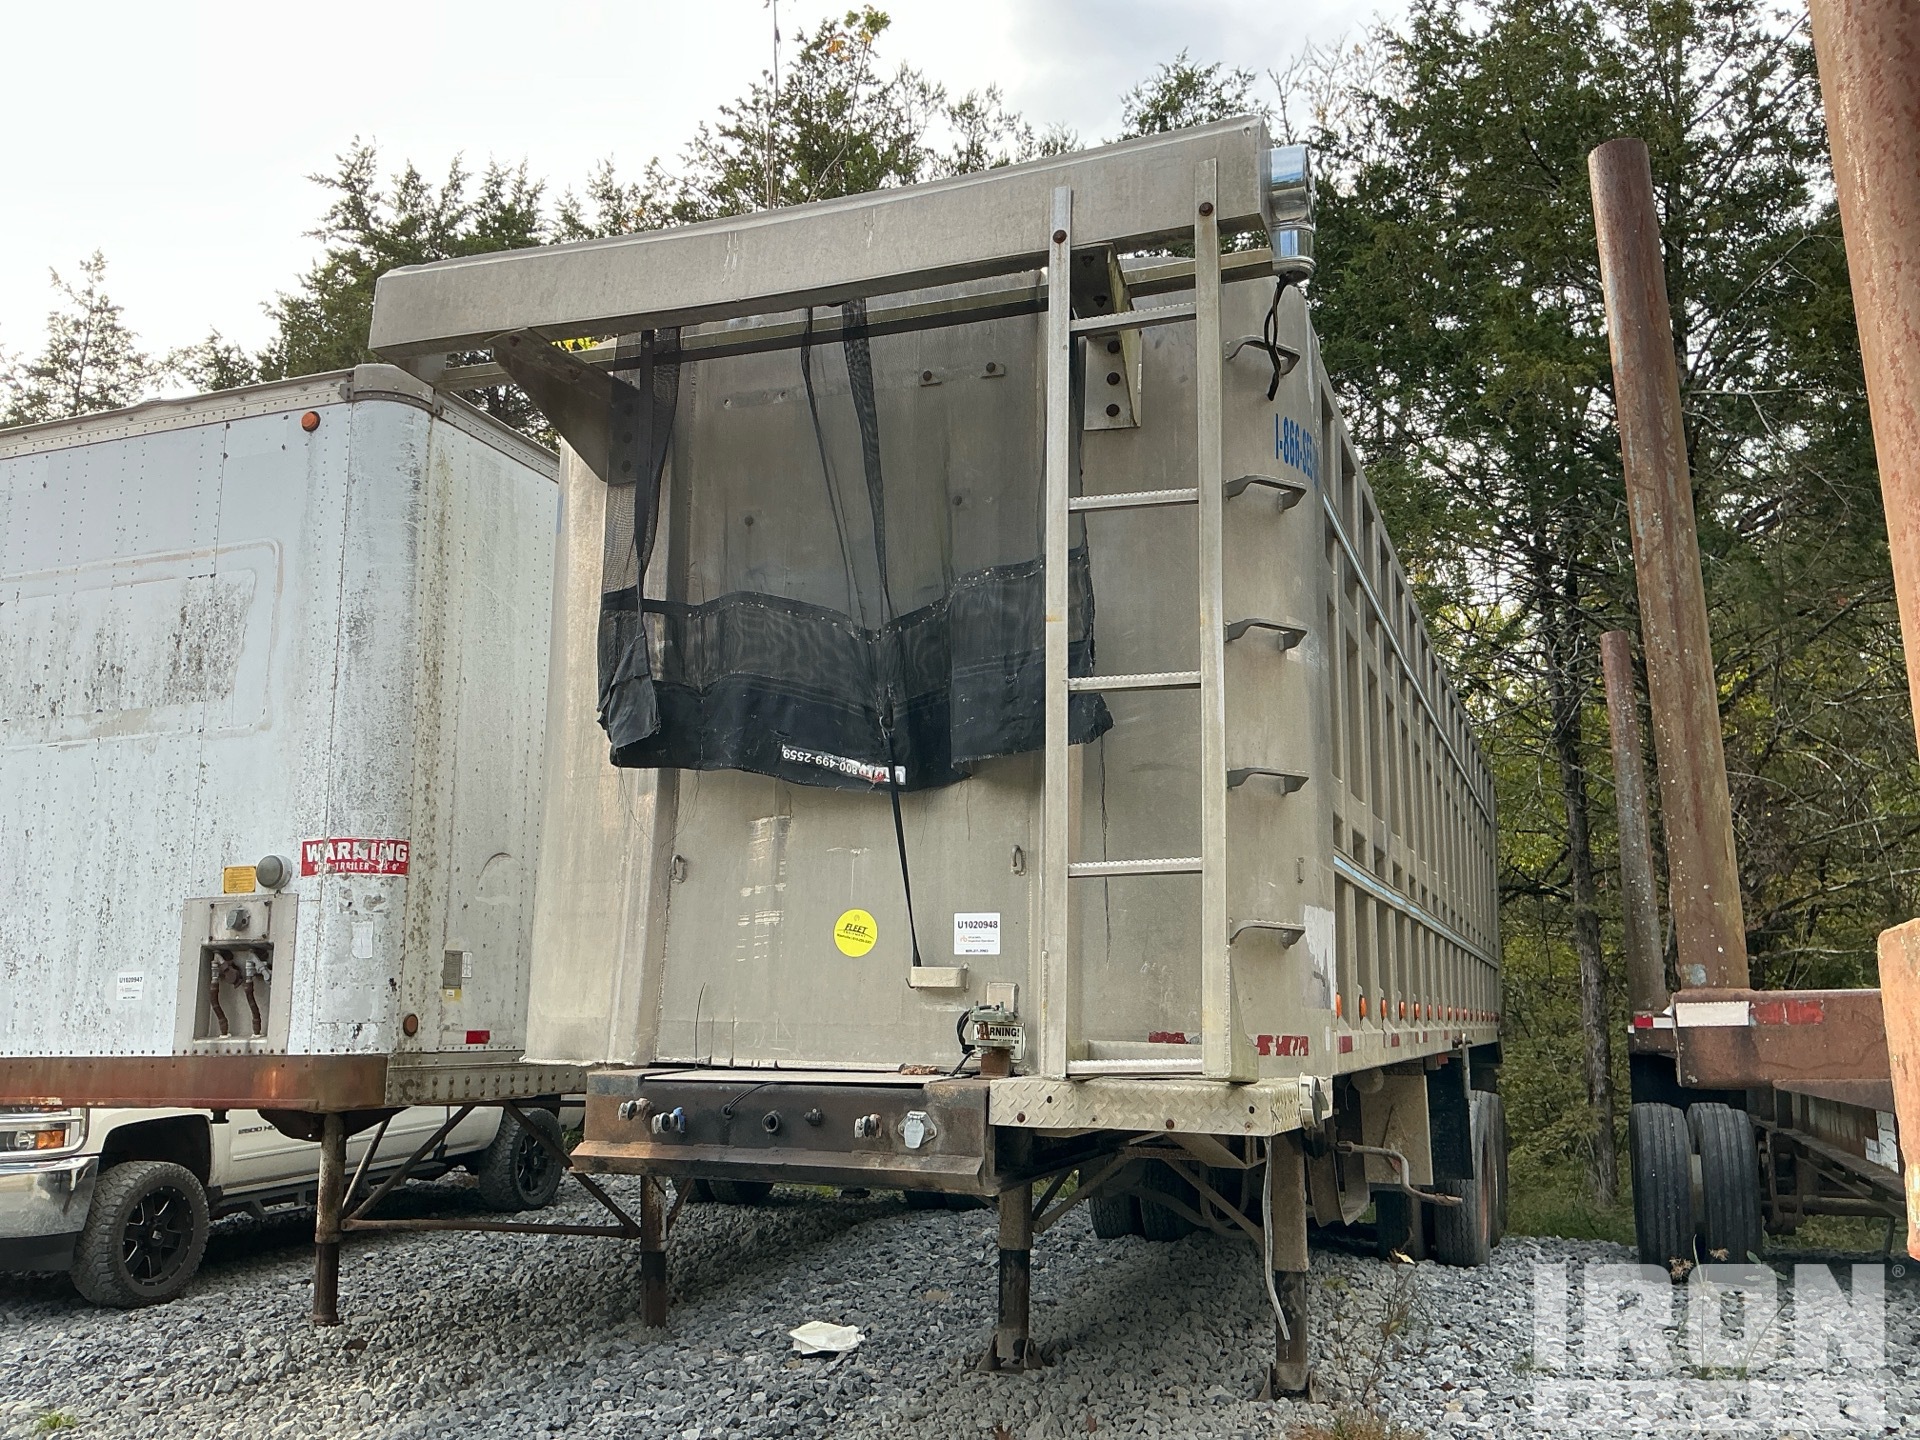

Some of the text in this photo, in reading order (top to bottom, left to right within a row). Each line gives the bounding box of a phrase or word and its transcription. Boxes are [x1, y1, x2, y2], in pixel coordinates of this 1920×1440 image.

[306, 841, 408, 862] WARNING
[844, 922, 868, 934] FLEET
[957, 920, 998, 929] U1020948
[977, 1026, 1020, 1038] RNING!
